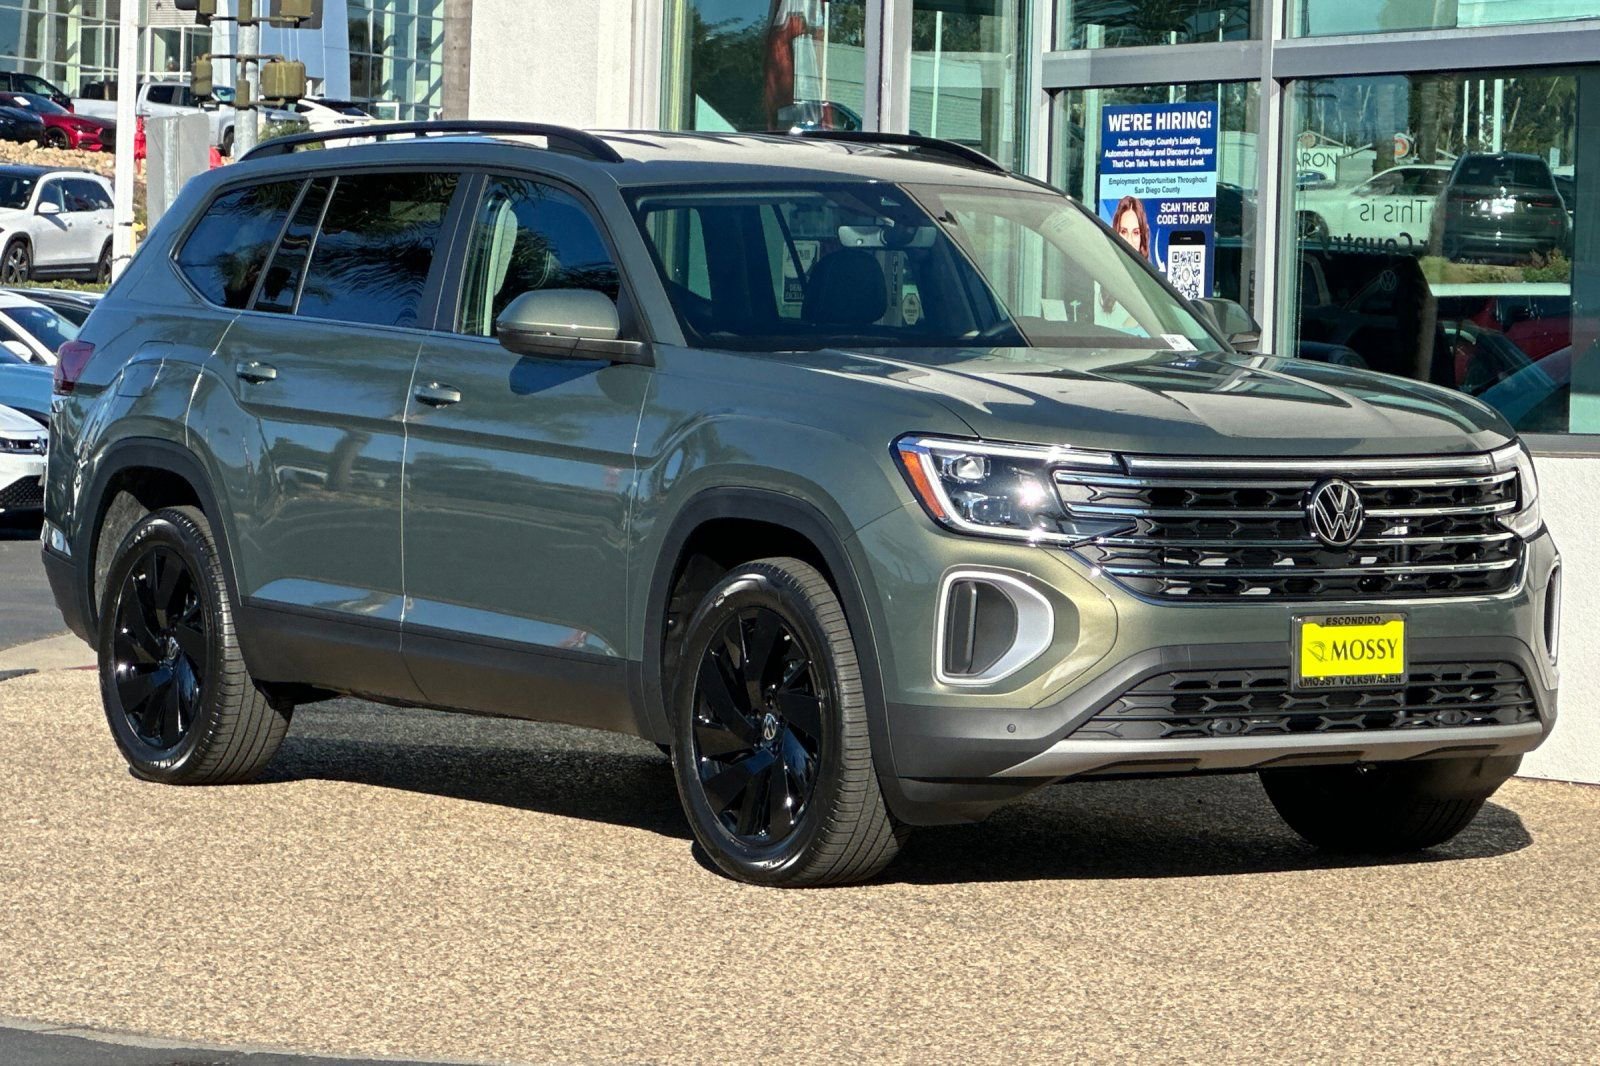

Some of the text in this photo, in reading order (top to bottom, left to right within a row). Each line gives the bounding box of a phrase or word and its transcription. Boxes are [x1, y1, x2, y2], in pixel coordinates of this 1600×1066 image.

[1108, 110, 1212, 132] WE'RE HIRING!
[1117, 138, 1128, 147] Join
[1129, 138, 1139, 146] San
[1140, 137, 1155, 147] Diego
[1179, 136, 1200, 146] Leading
[1105, 149, 1134, 158] Automotive
[1135, 148, 1155, 157] Retailer
[1156, 148, 1165, 156] and
[1167, 147, 1189, 156] Discover
[1195, 147, 1213, 155] Career
[1112, 159, 1124, 168] That
[1124, 159, 1135, 168] Can
[1136, 159, 1148, 167] Take
[1149, 159, 1159, 167] You
[1160, 159, 1166, 167] to
[1176, 158, 1189, 166] Next
[1109, 176, 1207, 186] Employment Opportunities Throughout
[1135, 186, 1180, 195] San Diego County
[1160, 201, 1209, 213] SCAN THE QR
[1156, 213, 1213, 225] CODE TO APPLY
[1325, 616, 1381, 626] ESCONDIDO
[1331, 638, 1398, 661] MOSSY
[1304, 674, 1402, 687] MOSSY VOLKSWAGEN
